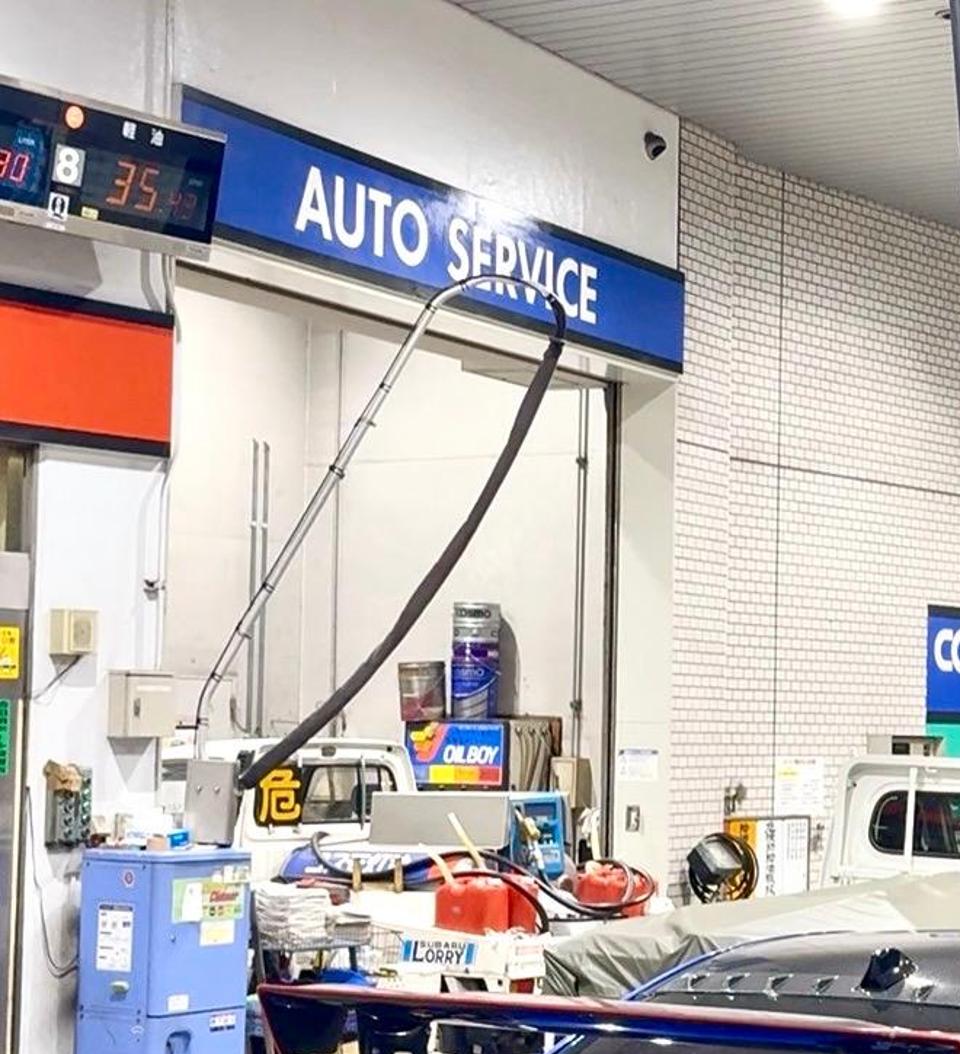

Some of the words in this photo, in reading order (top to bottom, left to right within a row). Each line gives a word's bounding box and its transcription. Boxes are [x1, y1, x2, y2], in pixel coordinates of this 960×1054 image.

[56, 147, 80, 184] 8
[294, 165, 429, 268] AUTO
[446, 217, 598, 325] SERVICE
[259, 769, 301, 822] 危
[412, 940, 466, 965] LORRY
[420, 940, 466, 949] SUBARU
